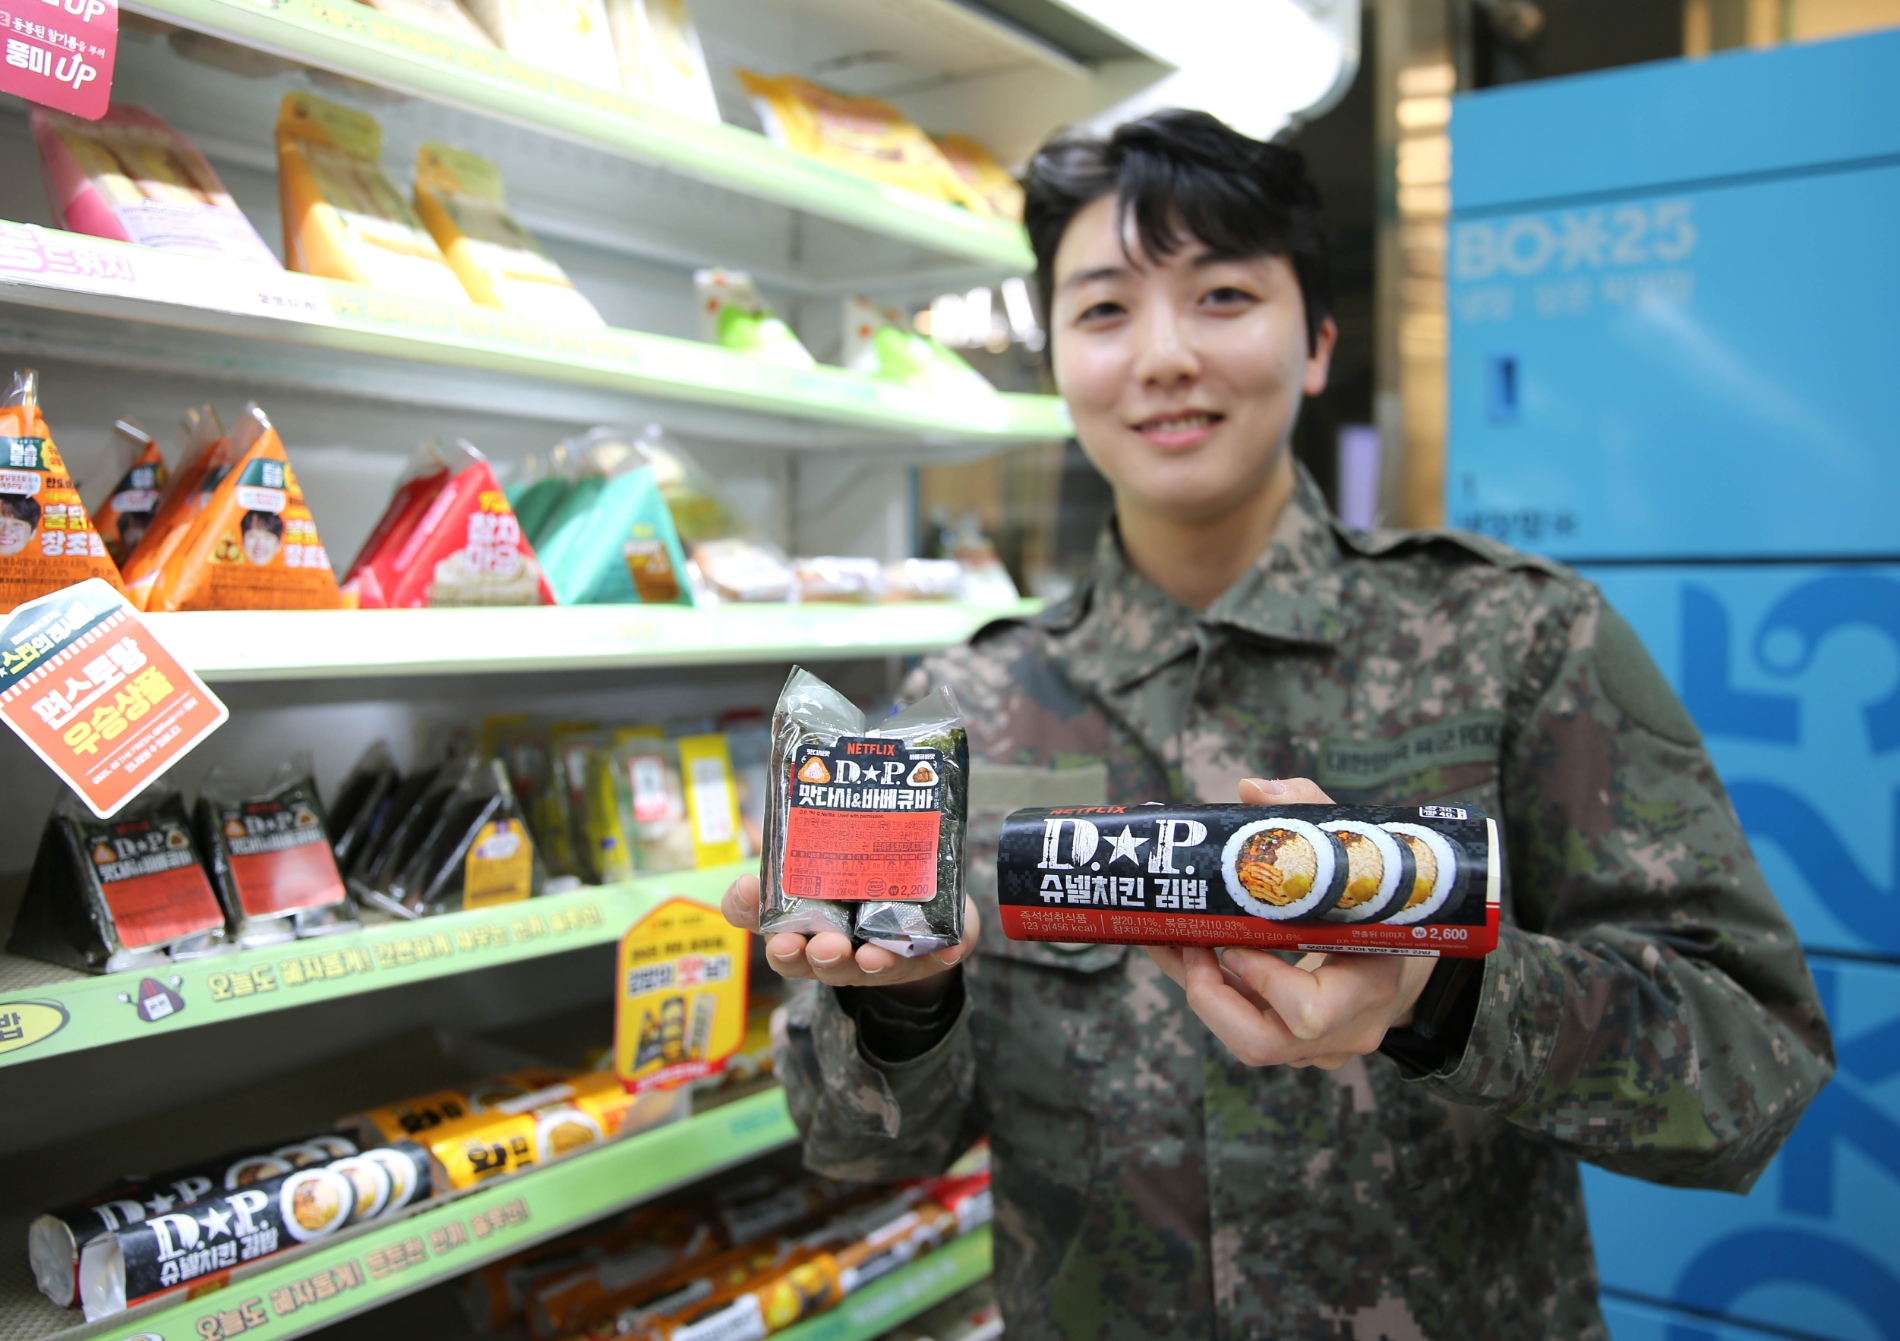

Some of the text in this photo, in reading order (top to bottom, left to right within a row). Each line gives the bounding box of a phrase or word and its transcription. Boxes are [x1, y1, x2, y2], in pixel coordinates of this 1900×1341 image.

[64, 0, 106, 22] UP
[12, 17, 45, 39] 동봉된
[47, 28, 87, 52] 참기름을
[5, 38, 97, 90] 풍미 UP
[1454, 200, 1697, 281] BOX25
[30, 635, 148, 731] 편스토랑
[62, 665, 175, 756] 우승상품
[846, 742, 896, 756] NETFLIX
[798, 784, 934, 810] 맛다시&바베큐바
[1050, 806, 1127, 815] NETFLIX
[900, 884, 929, 897] 2,200
[1039, 874, 1209, 910] 슈넬치킨 김밥
[1019, 910, 1087, 924] 즉석섭취식품
[1022, 921, 1097, 933] 123 g(456 kcal)
[1351, 929, 1406, 939] 연출된 이미지
[1429, 927, 1468, 940] 2,600
[208, 963, 278, 1003] 오늘도
[241, 1226, 279, 1260] 김밥
[196, 1297, 269, 1341] 오늘도
